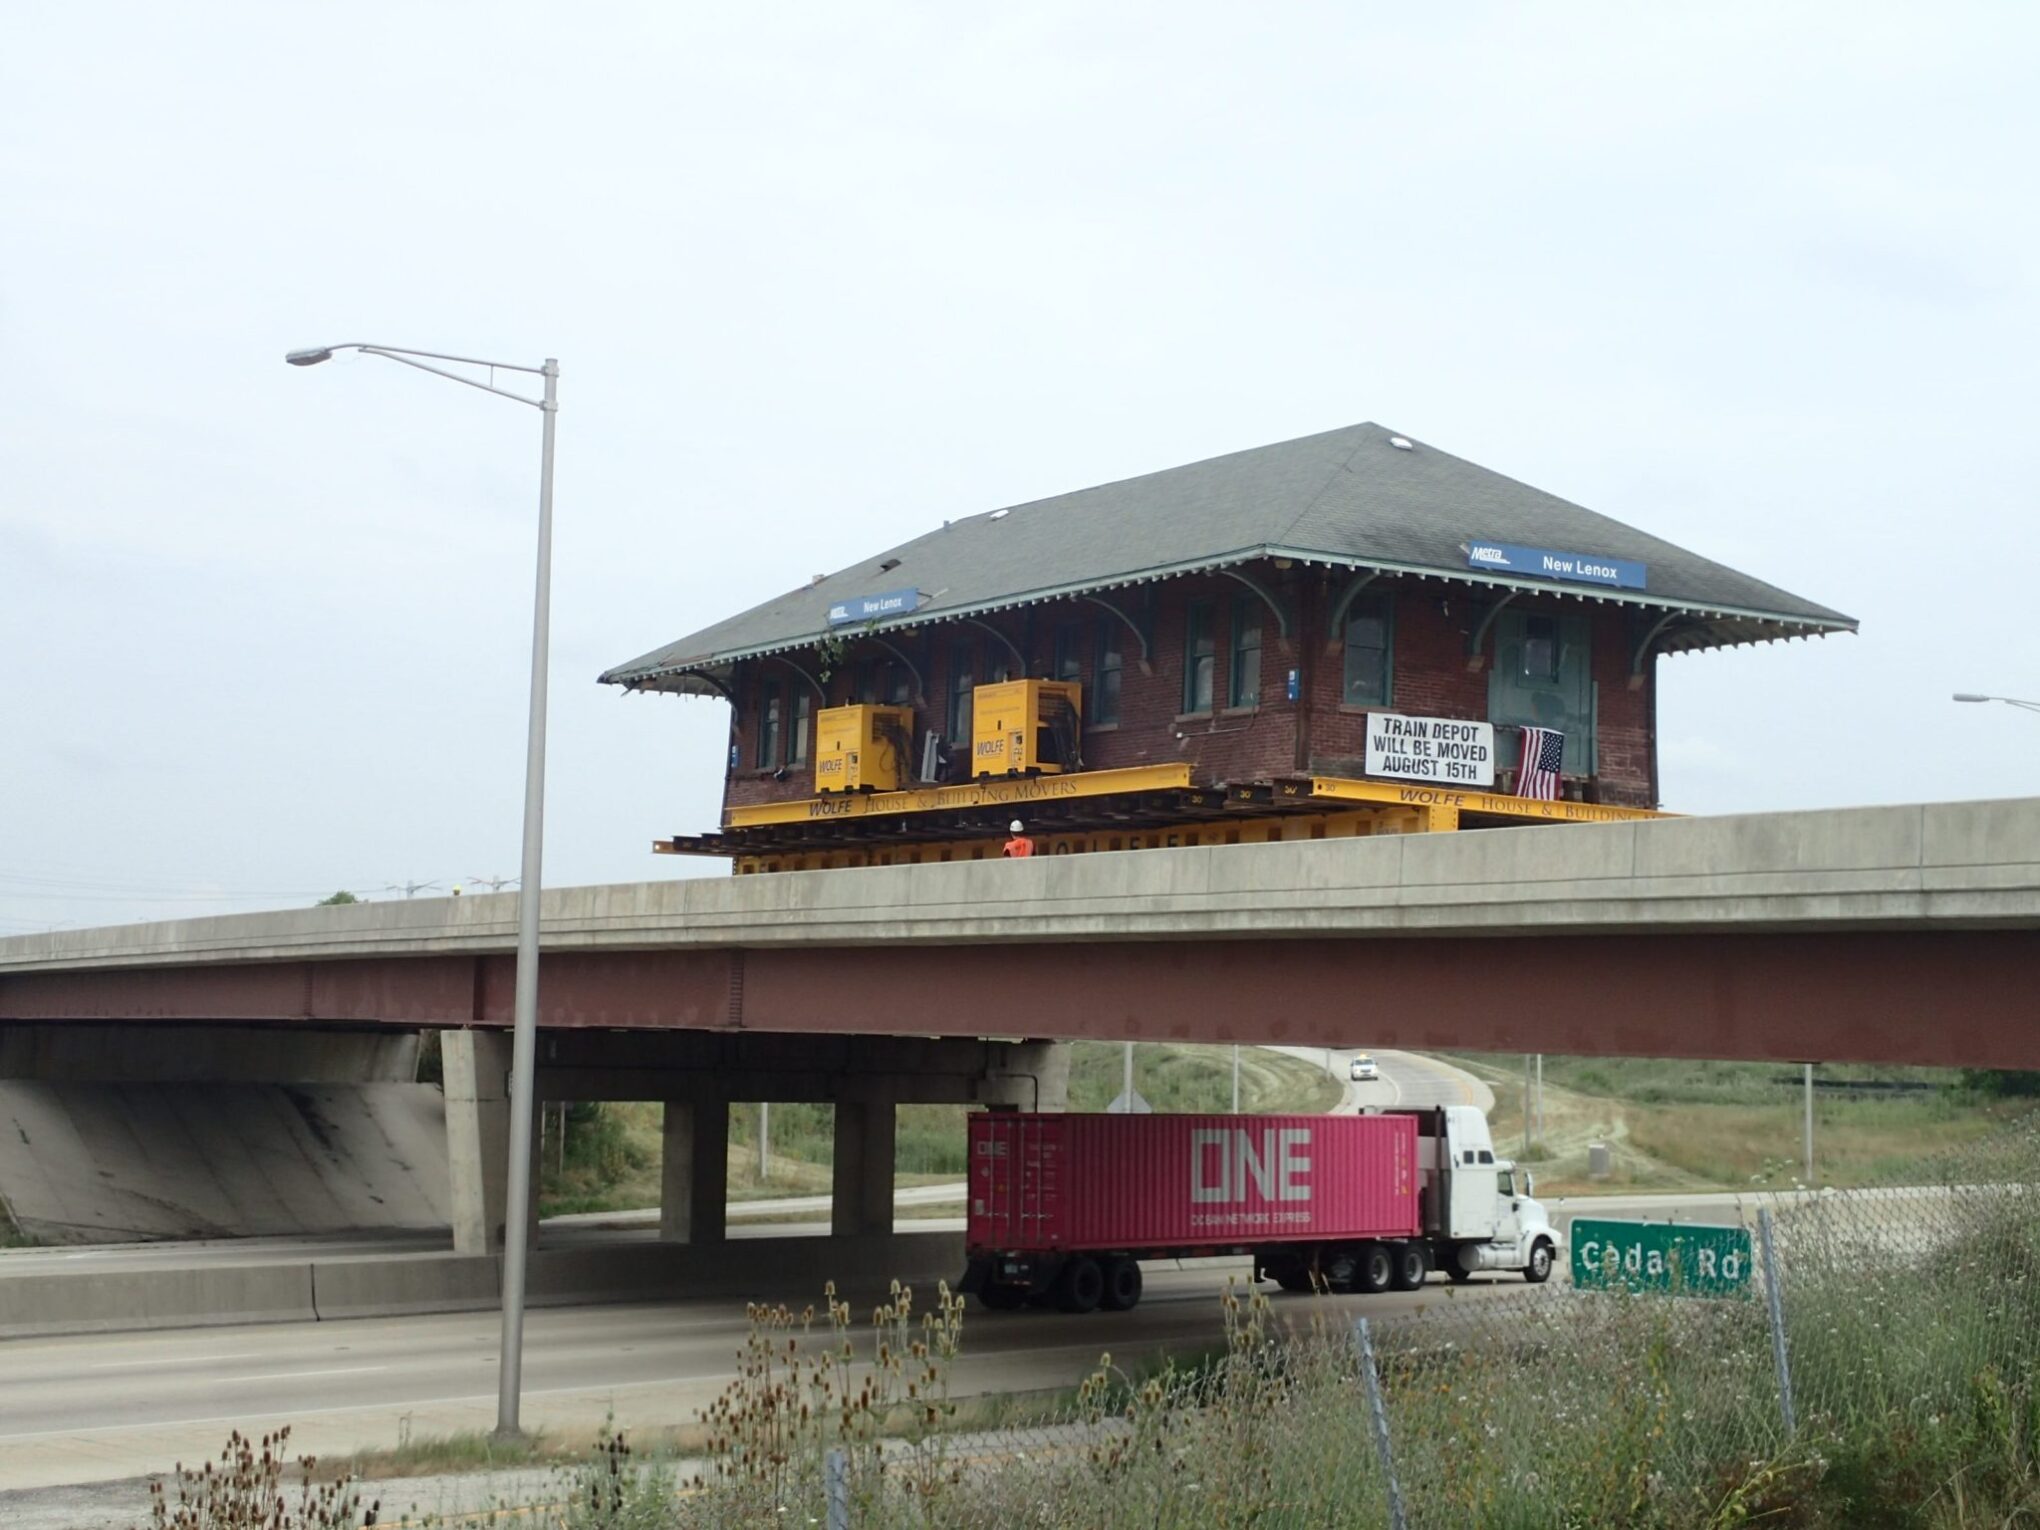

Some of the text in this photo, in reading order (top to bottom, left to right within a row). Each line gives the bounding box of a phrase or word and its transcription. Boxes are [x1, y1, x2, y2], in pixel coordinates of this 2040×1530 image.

[1471, 547, 1503, 560] Metra
[1543, 556, 1617, 579] New Lenox
[863, 598, 902, 613] New Lenox
[1384, 718, 1479, 742] TRAIN DEPOT
[976, 739, 1004, 755] WOLFE
[1374, 735, 1487, 761] WILL BE MOVED
[820, 758, 842, 773] WOLFE
[1382, 756, 1477, 779] AUGUST 15TH
[809, 780, 1077, 816] WOLFE HOUSE & BUILDING MOVERS
[1401, 790, 1466, 807] WOLFE
[1482, 797, 1532, 813] HOUSE
[1541, 805, 1552, 815] &
[1191, 1129, 1311, 1202] ONE
[1698, 1248, 1740, 1279] Rd
